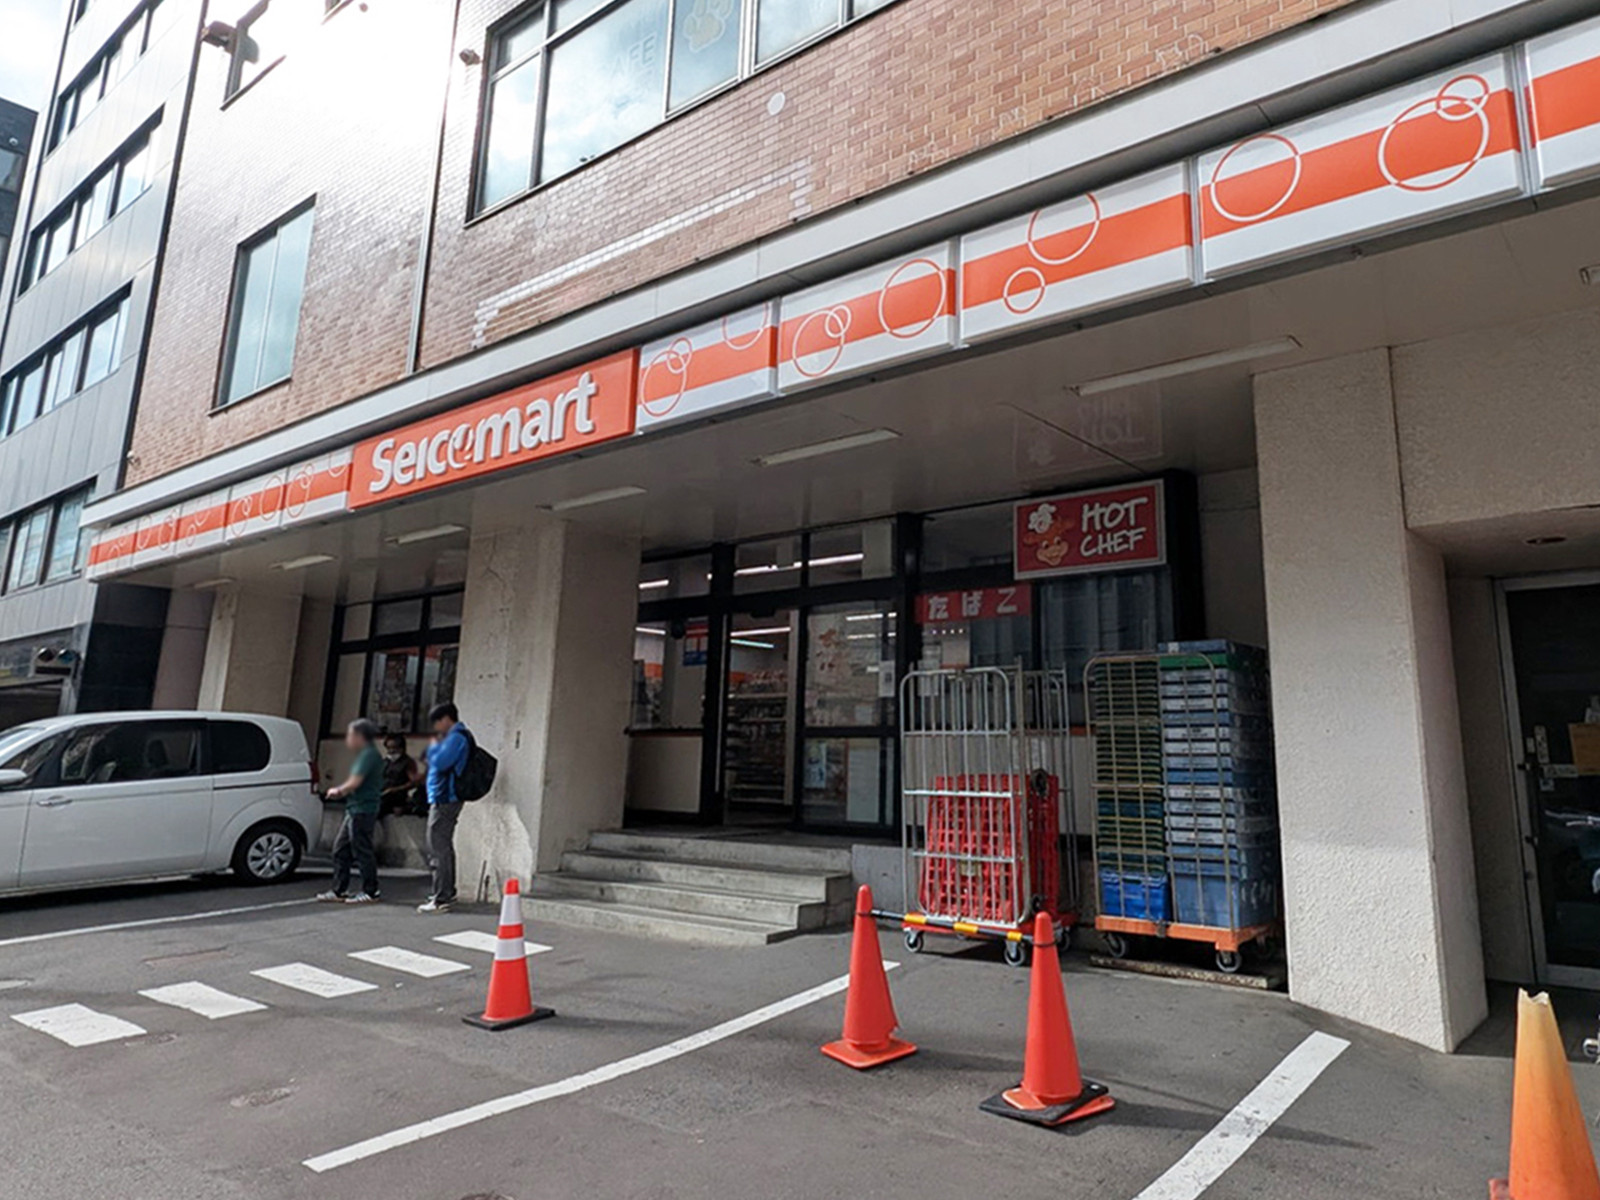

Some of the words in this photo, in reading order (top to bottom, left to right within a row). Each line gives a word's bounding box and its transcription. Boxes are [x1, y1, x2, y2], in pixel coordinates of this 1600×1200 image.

[369, 371, 597, 493] Seicomart
[1081, 497, 1148, 532] HOT
[1080, 526, 1147, 557] CHEF
[928, 587, 1018, 620] たばこ
